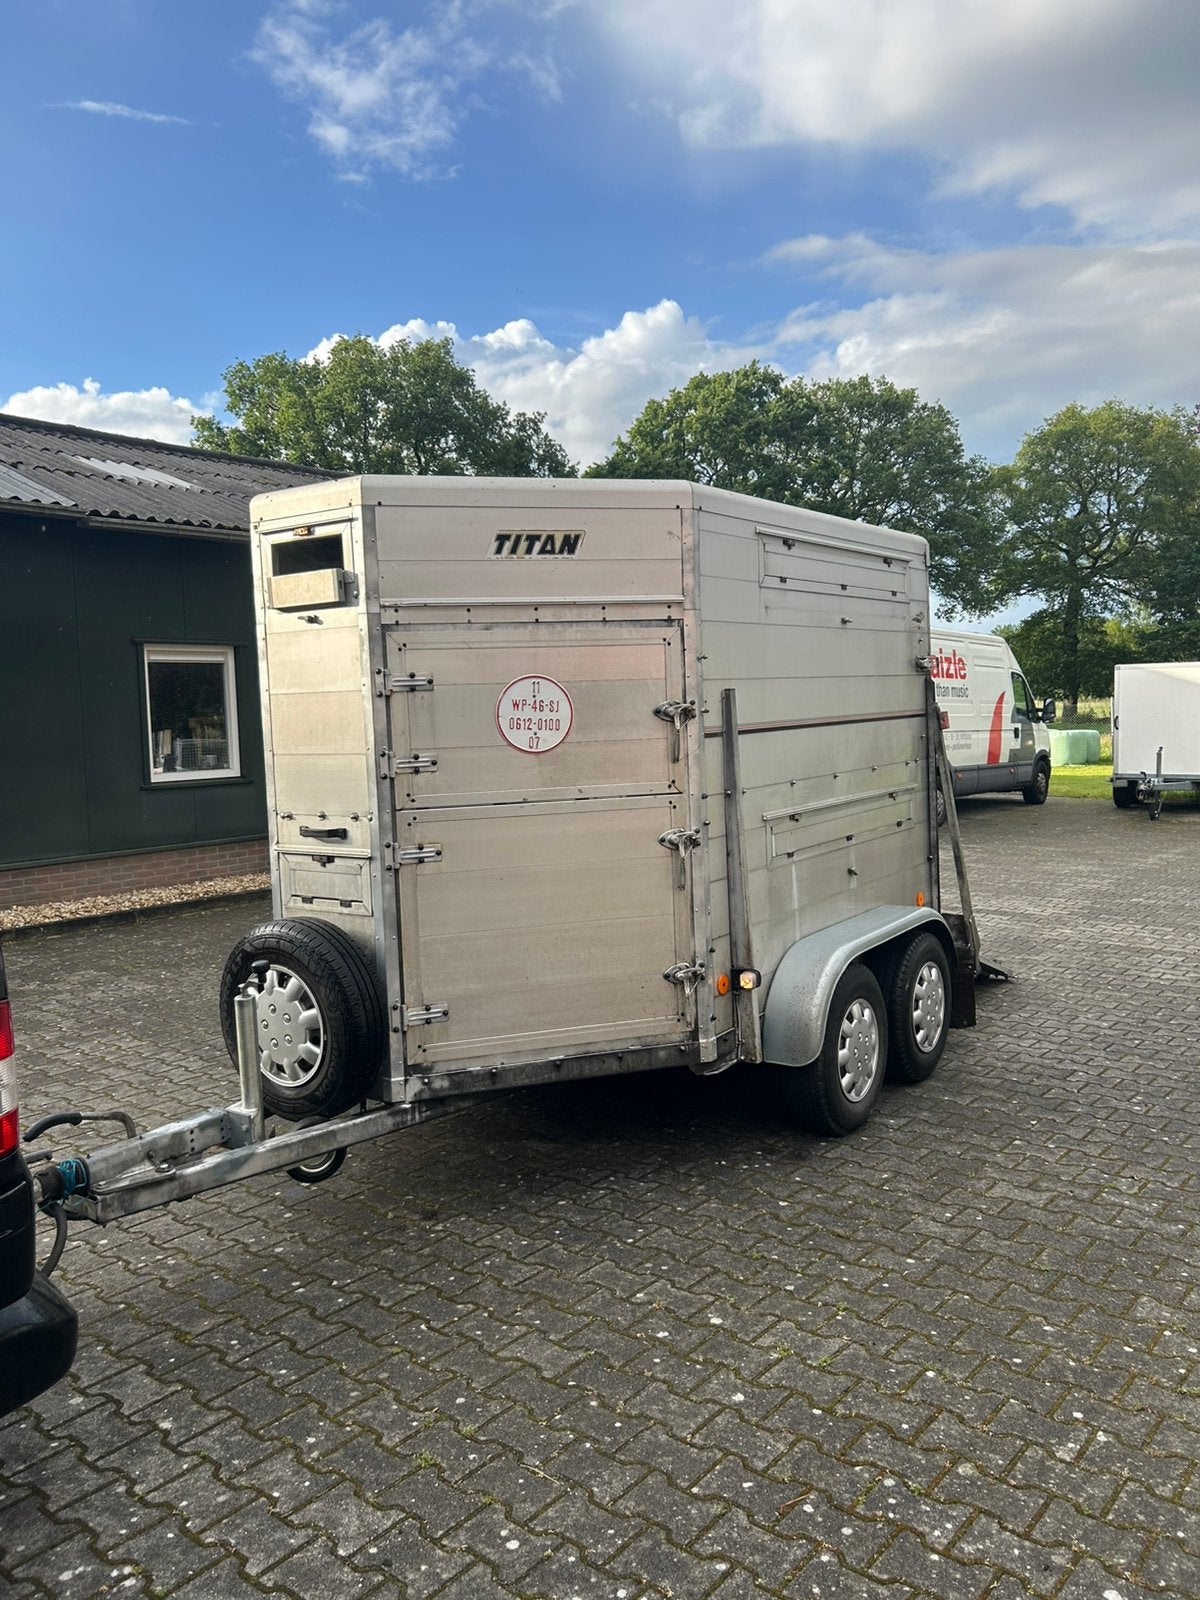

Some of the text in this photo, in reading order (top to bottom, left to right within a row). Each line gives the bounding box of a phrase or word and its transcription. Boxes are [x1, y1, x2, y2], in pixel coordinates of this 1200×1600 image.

[493, 533, 582, 556] TITAN
[531, 680, 540, 694] 11
[936, 683, 969, 698] than music
[511, 698, 560, 713] WP-46-SJ
[508, 716, 561, 732] 0612-0100
[528, 735, 541, 749] 07
